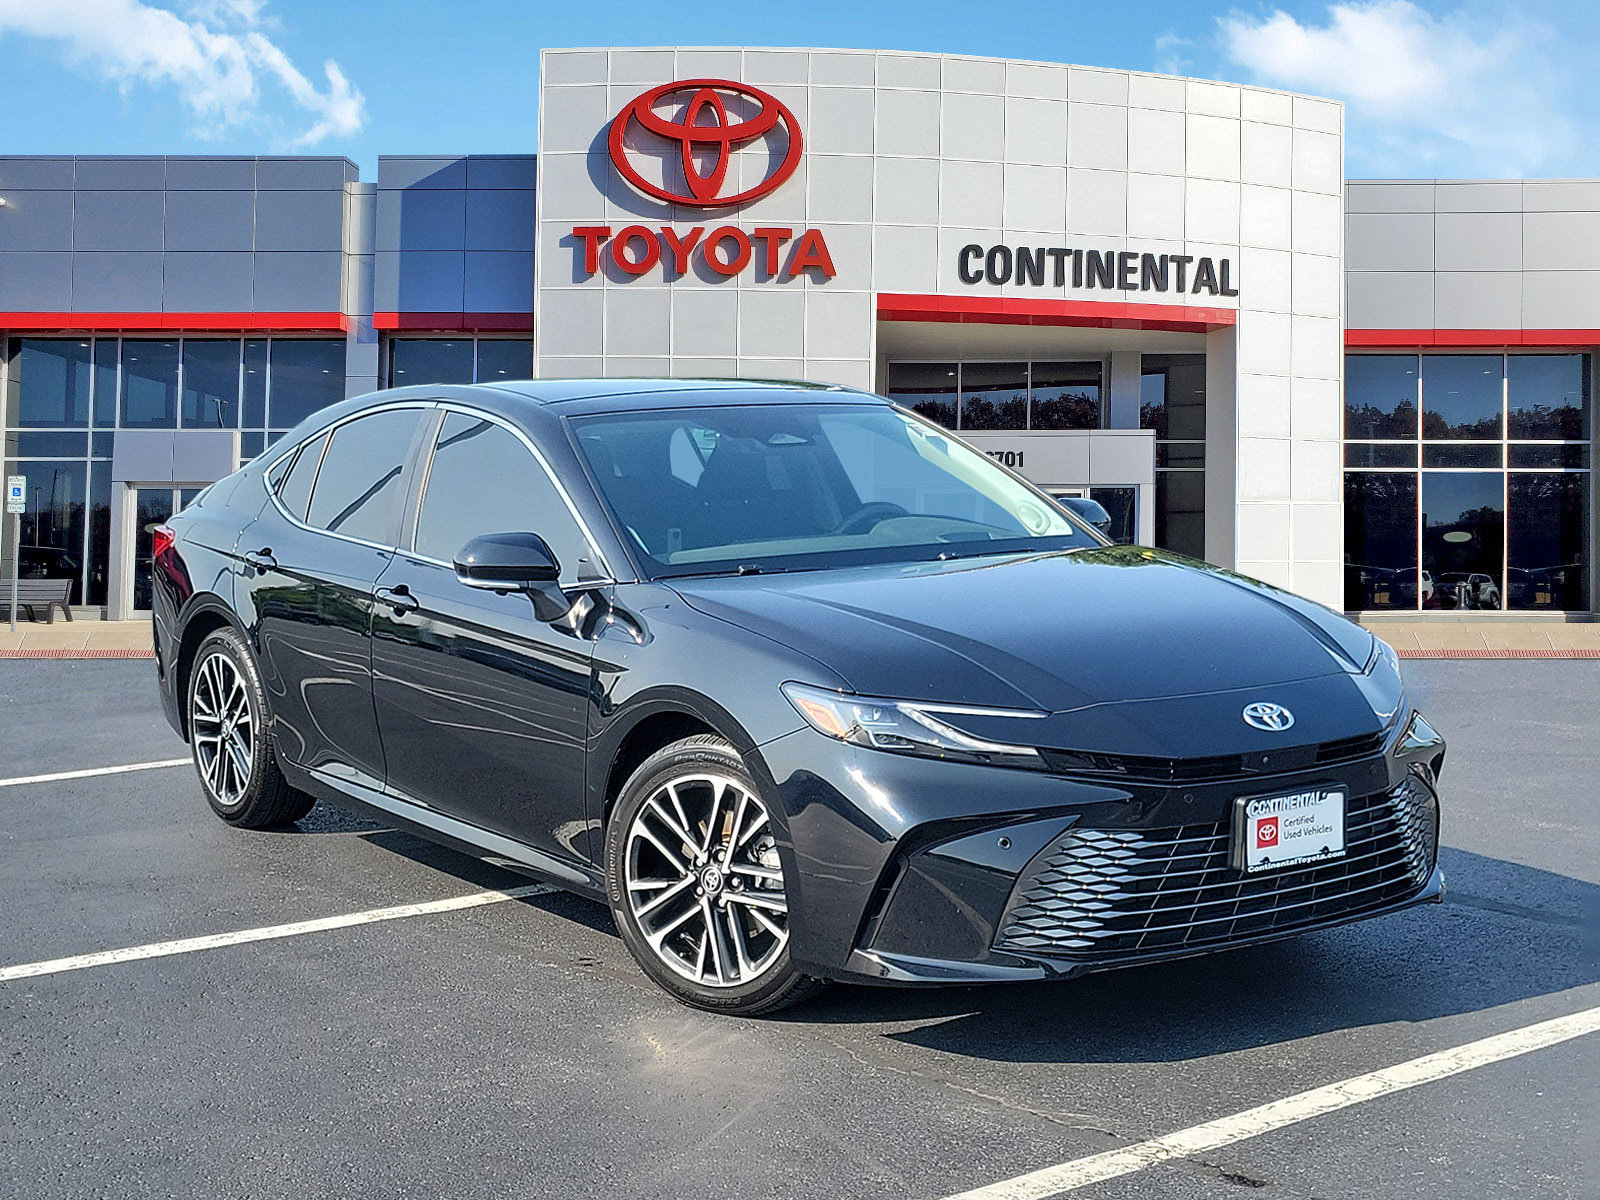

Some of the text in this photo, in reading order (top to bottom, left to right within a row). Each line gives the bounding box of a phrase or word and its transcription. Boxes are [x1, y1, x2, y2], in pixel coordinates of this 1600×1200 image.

[572, 225, 836, 277] TOYOTA
[958, 244, 1238, 296] CONTINENTAL
[1246, 791, 1321, 817] CONTINENTAL
[1283, 814, 1315, 828] Certified
[1283, 825, 1333, 840] Used Vehicles
